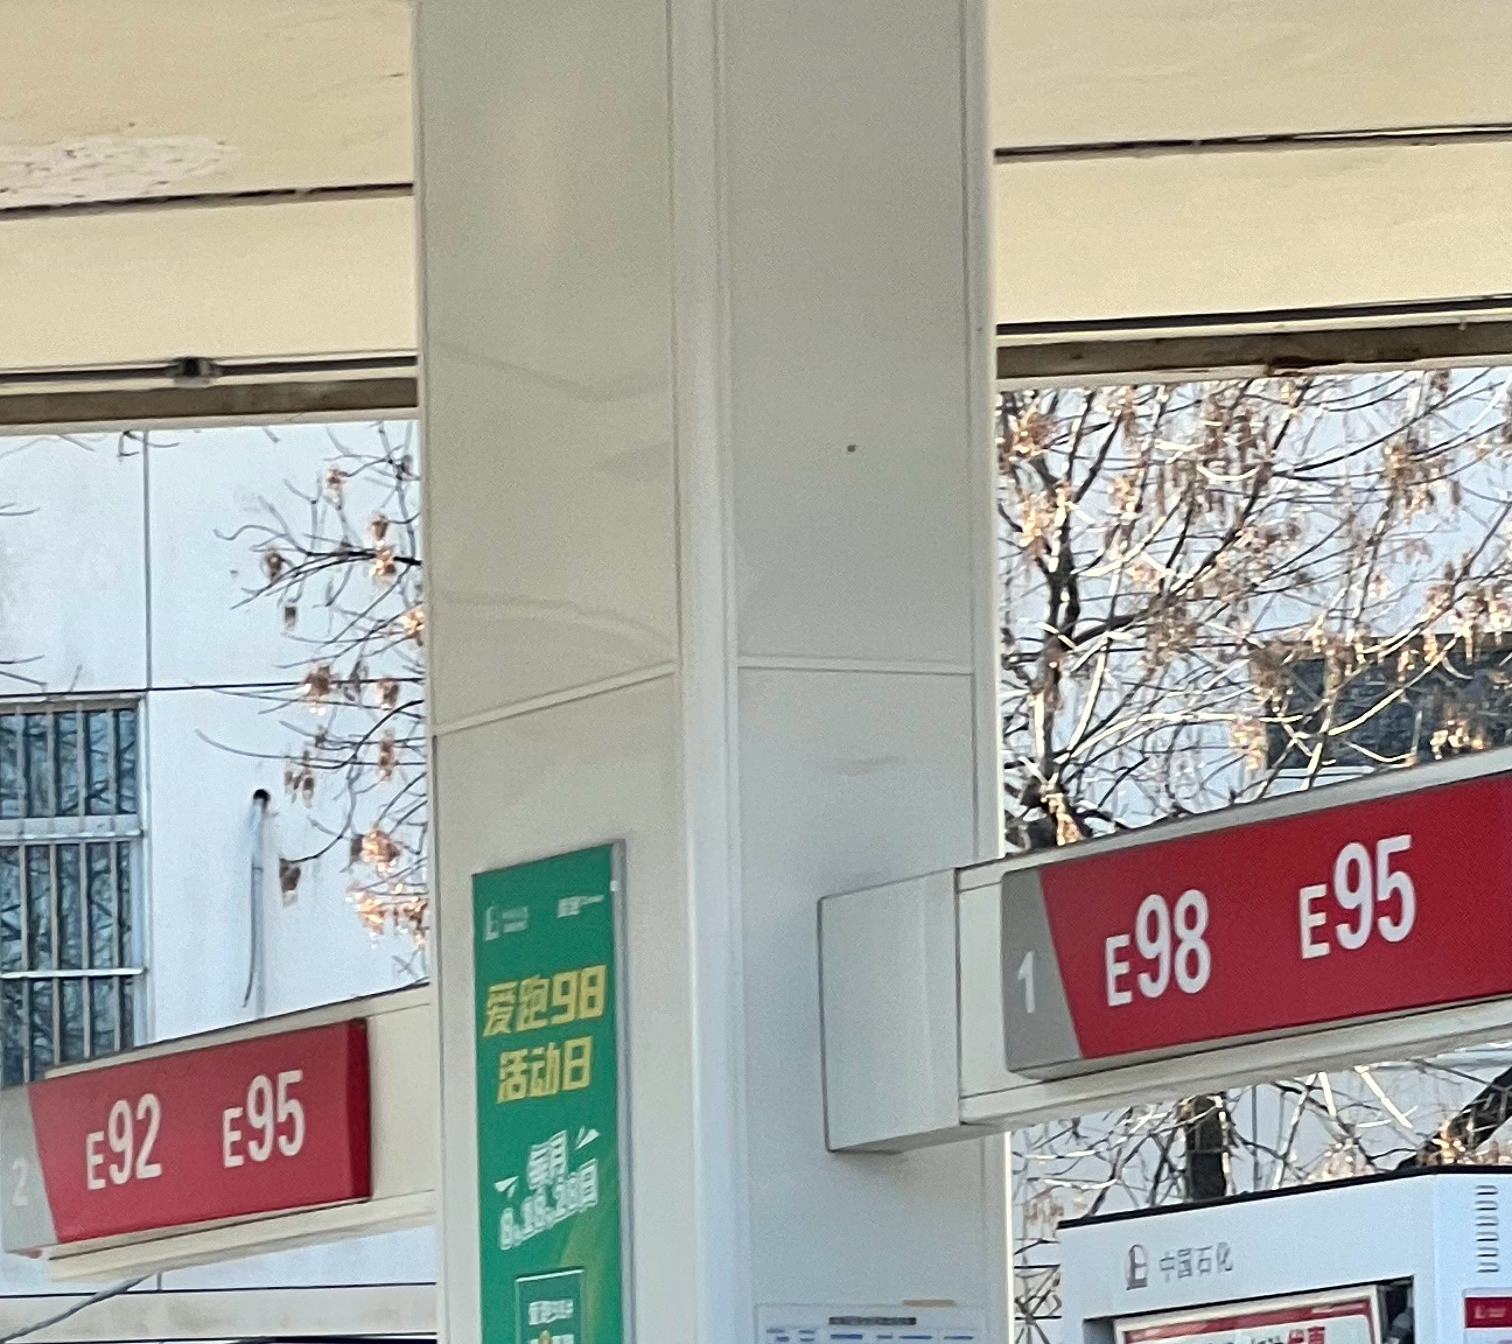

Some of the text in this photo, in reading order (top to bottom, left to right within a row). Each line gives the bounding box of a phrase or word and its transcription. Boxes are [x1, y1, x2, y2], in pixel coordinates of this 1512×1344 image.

[1017, 833, 1418, 1014] 1 E98 E95
[496, 1036, 593, 1104] 活动日
[11, 1069, 306, 1207] 2 E92 E95
[1159, 1240, 1234, 1282] 中国石化
